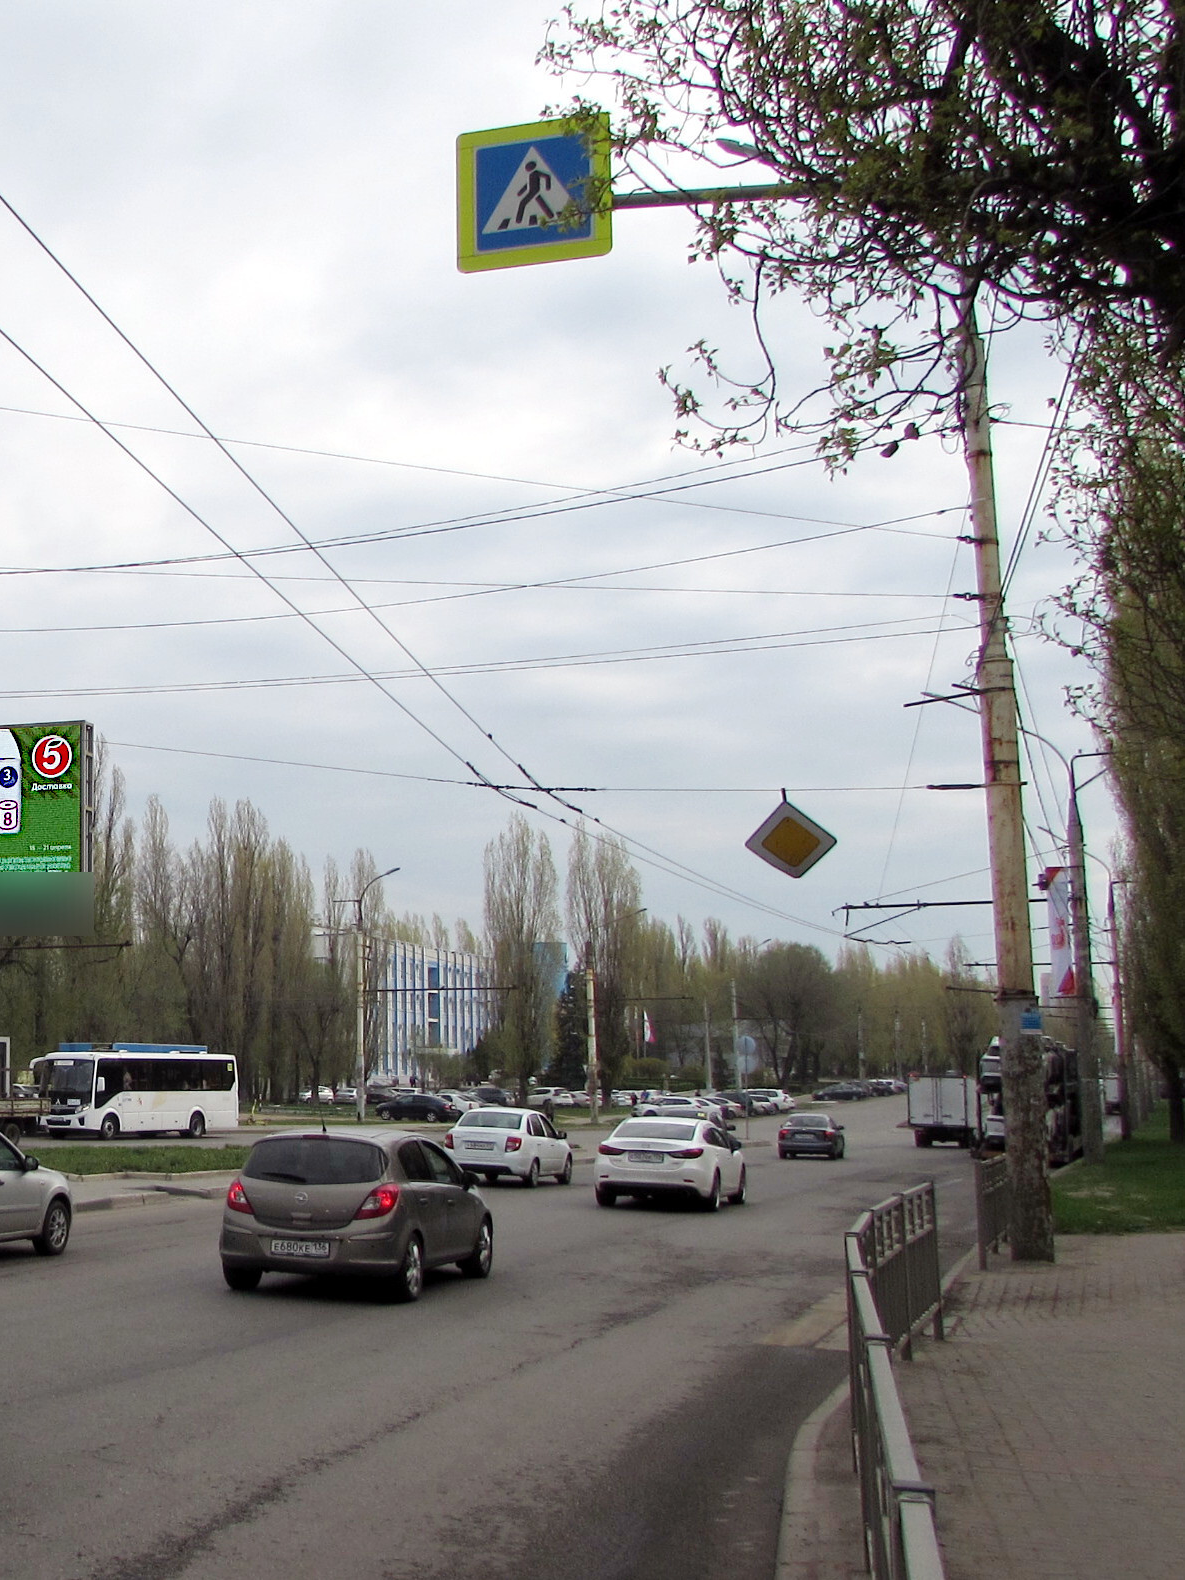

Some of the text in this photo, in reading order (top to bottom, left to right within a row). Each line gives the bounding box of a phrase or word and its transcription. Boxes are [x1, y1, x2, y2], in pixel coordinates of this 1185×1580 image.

[3, 769, 11, 781] 3
[31, 783, 73, 791] Доставка
[3, 812, 12, 826] 8
